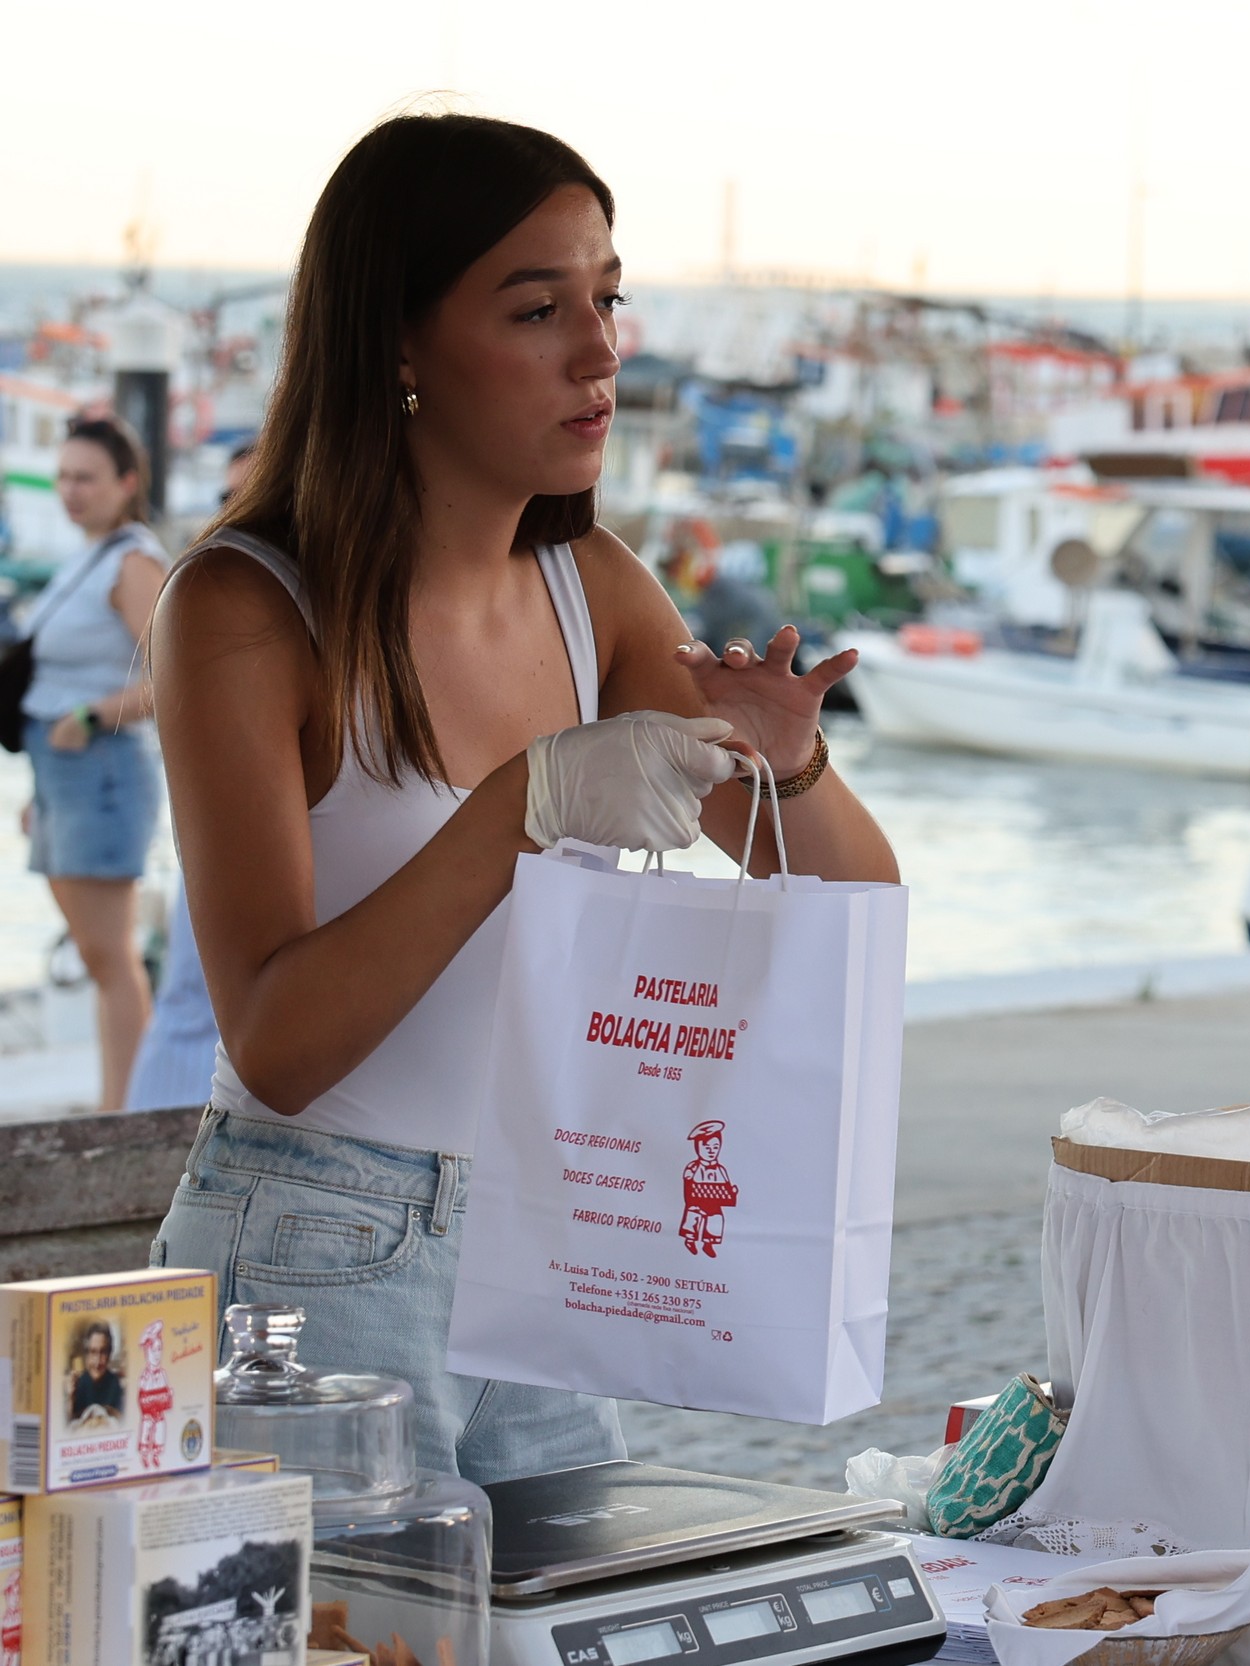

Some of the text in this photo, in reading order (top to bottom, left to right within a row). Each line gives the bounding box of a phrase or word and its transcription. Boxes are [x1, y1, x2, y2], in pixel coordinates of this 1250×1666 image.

[633, 975, 718, 1007] PASTELARIA
[586, 1011, 671, 1054] BOLACHA
[638, 1061, 682, 1081] Desde 1855
[554, 1128, 642, 1154] DOCES REGIONAIS
[563, 1168, 646, 1193] DOCES CASEIROS
[572, 1208, 662, 1234] FABRICO PRÓPRIO
[548, 1259, 562, 1272] Av.
[563, 1262, 589, 1277] Luisa
[591, 1266, 618, 1282] Todi,
[619, 1271, 639, 1284] 502
[646, 1274, 671, 1288] 2900
[674, 1278, 729, 1295] SETÚBAL
[569, 1281, 702, 1310] Telefone +351 265 230 875
[565, 1298, 706, 1328] bolacha.piedade@gmail.com
[778, 1614, 794, 1628] kg
[676, 1630, 692, 1643] kg
[567, 1647, 599, 1664] CAS
